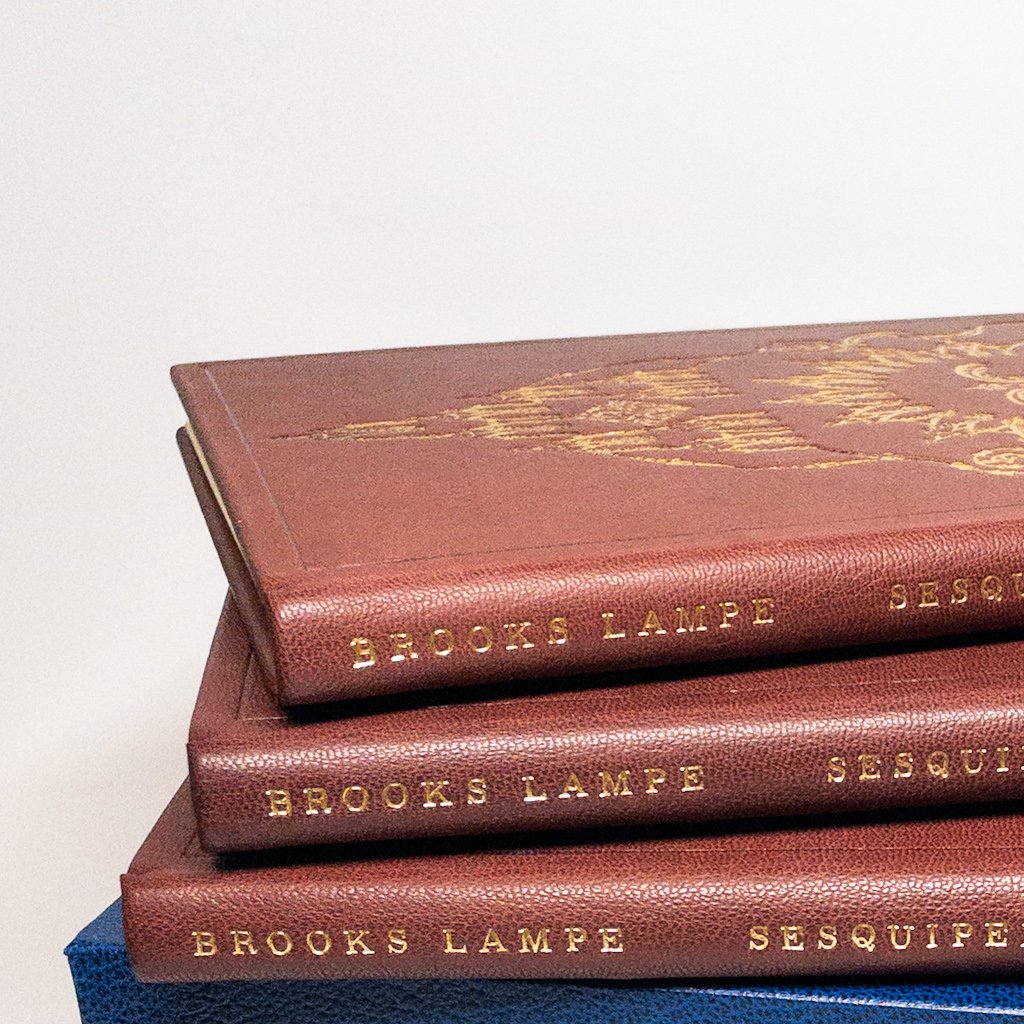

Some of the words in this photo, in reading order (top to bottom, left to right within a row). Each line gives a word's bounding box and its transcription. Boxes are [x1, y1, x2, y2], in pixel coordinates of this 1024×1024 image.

[350, 617, 567, 668] BROOKS
[602, 597, 774, 638] LAMPE
[266, 778, 487, 816] BROOKS
[522, 765, 704, 801] LAMPE
[193, 929, 408, 956] BROOKS
[443, 928, 624, 953] LAMPE
